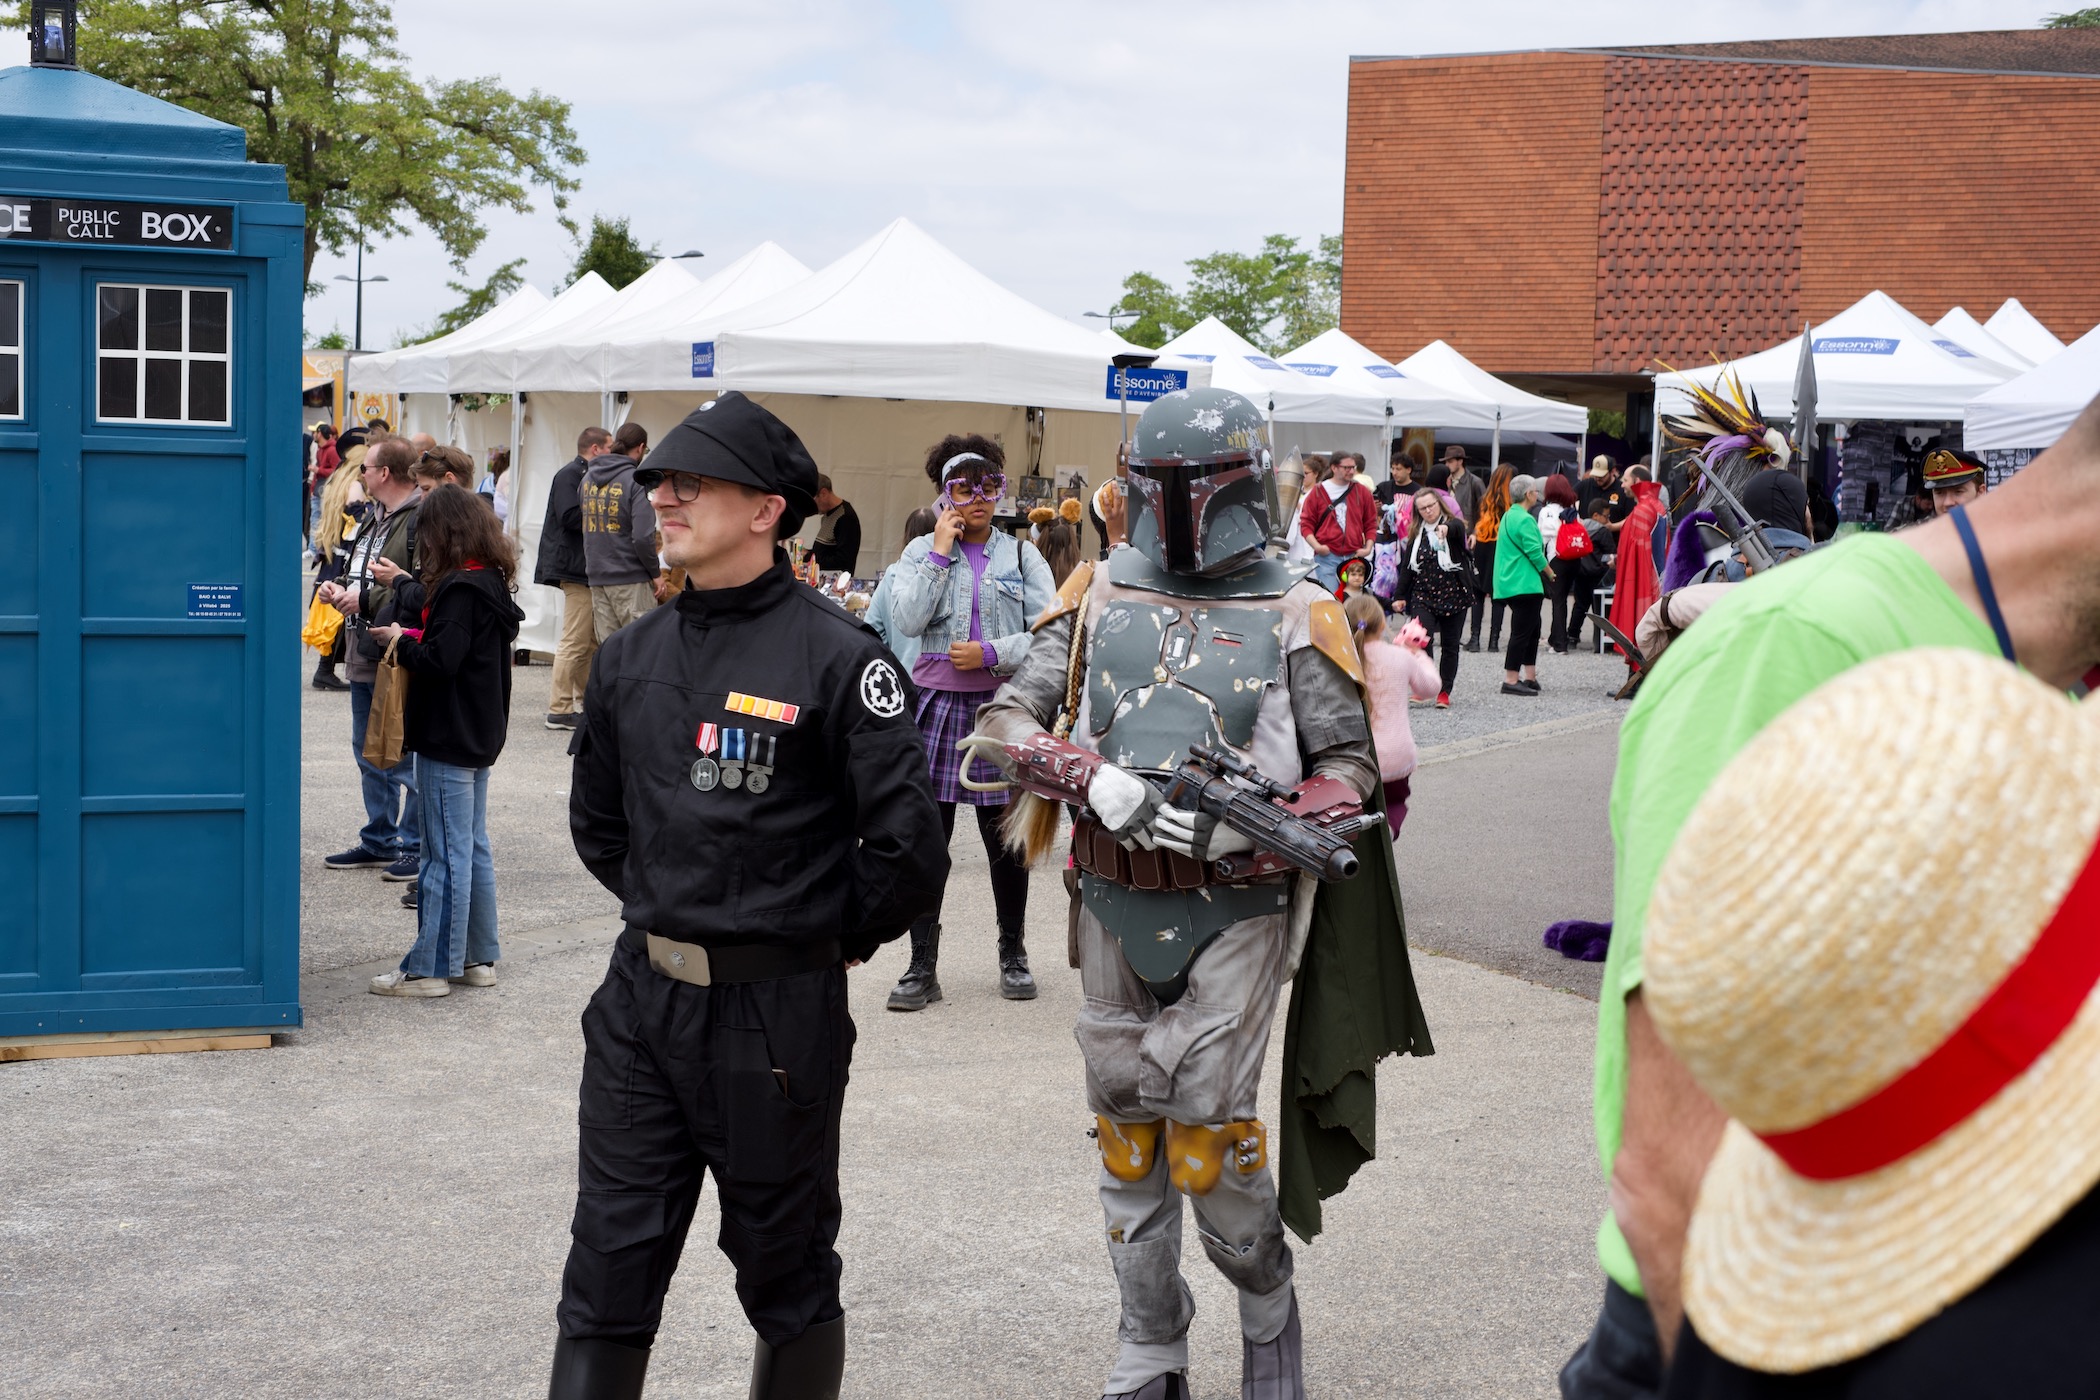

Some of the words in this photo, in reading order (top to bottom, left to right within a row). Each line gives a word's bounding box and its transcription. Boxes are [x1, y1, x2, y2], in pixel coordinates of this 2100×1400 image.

[58, 208, 120, 226] PUBLIC
[67, 224, 114, 239] CALL
[141, 211, 213, 242] BOX
